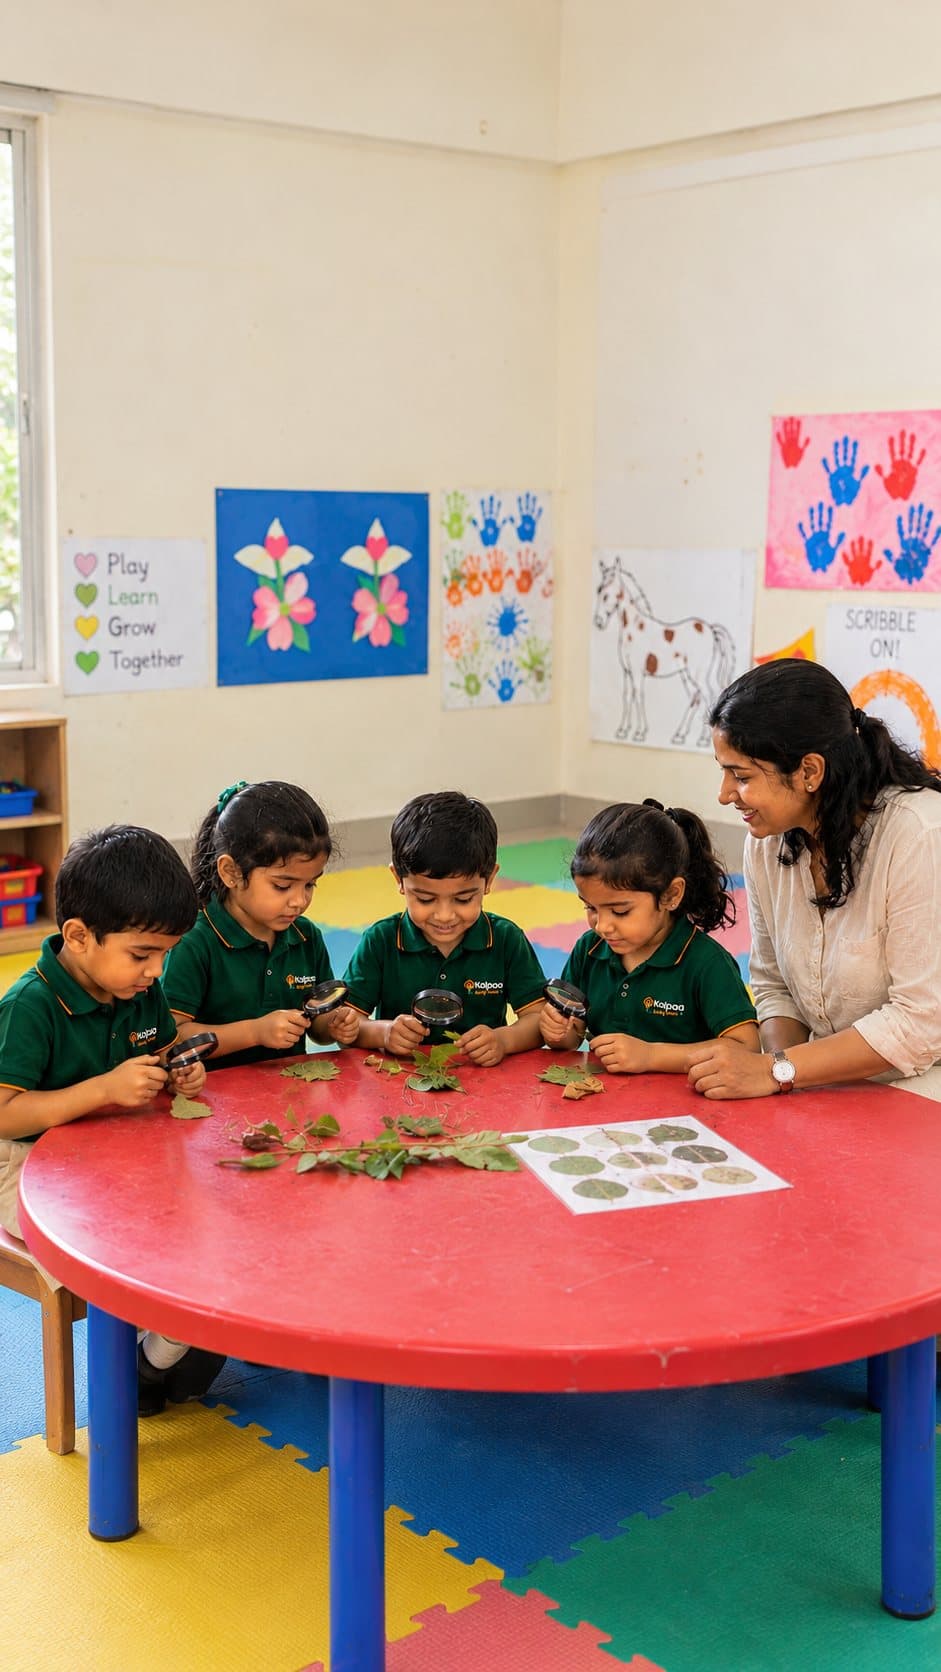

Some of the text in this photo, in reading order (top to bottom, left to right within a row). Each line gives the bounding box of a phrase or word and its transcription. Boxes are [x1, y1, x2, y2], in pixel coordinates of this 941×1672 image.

[107, 552, 149, 582] Play
[107, 584, 159, 606] Learn
[107, 616, 156, 637] Grow
[845, 608, 917, 632] SCRIBBLE
[870, 637, 901, 660] ON!
[109, 648, 184, 676] Together
